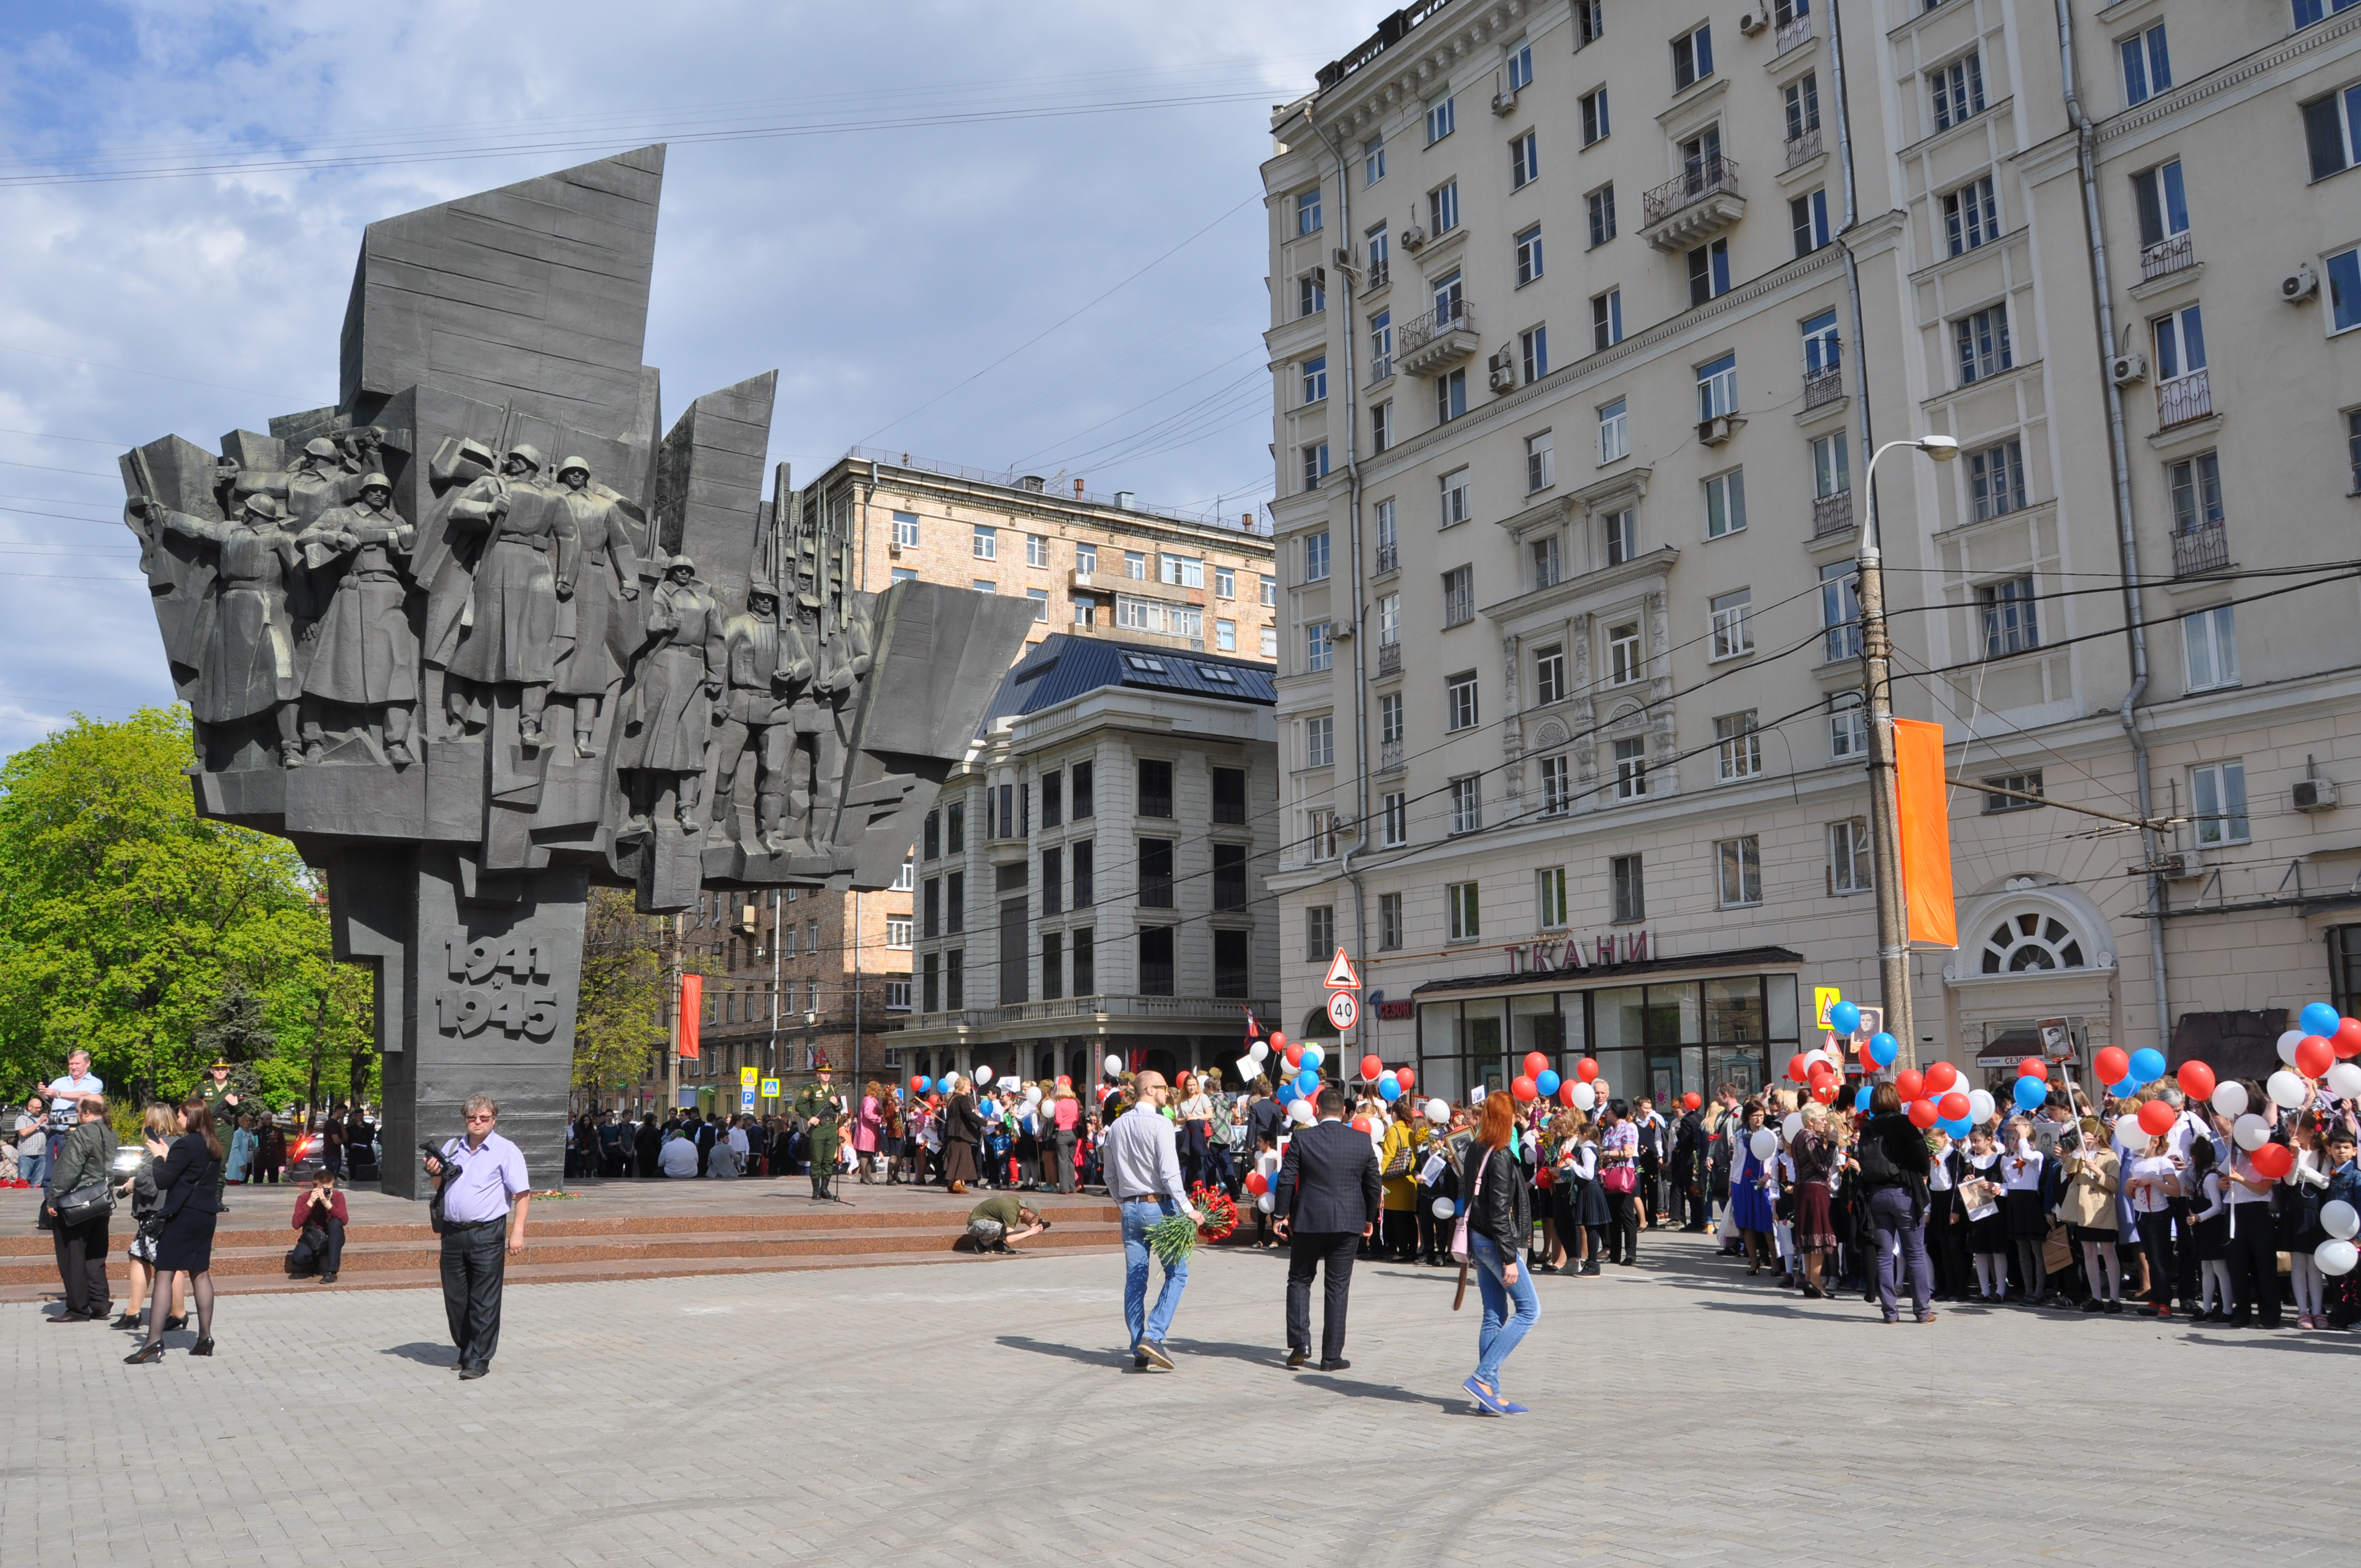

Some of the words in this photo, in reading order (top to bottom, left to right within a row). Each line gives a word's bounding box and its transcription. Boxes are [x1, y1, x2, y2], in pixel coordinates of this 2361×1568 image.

[445, 936, 551, 983] 1941
[1504, 930, 1651, 973] ТКАНИ
[436, 990, 557, 1036] 1945
[1335, 1003, 1352, 1017] 40
[1380, 1001, 1410, 1017] СЕЗОН
[2005, 1057, 2030, 1065] СЕЗО
[744, 1093, 752, 1103] P
